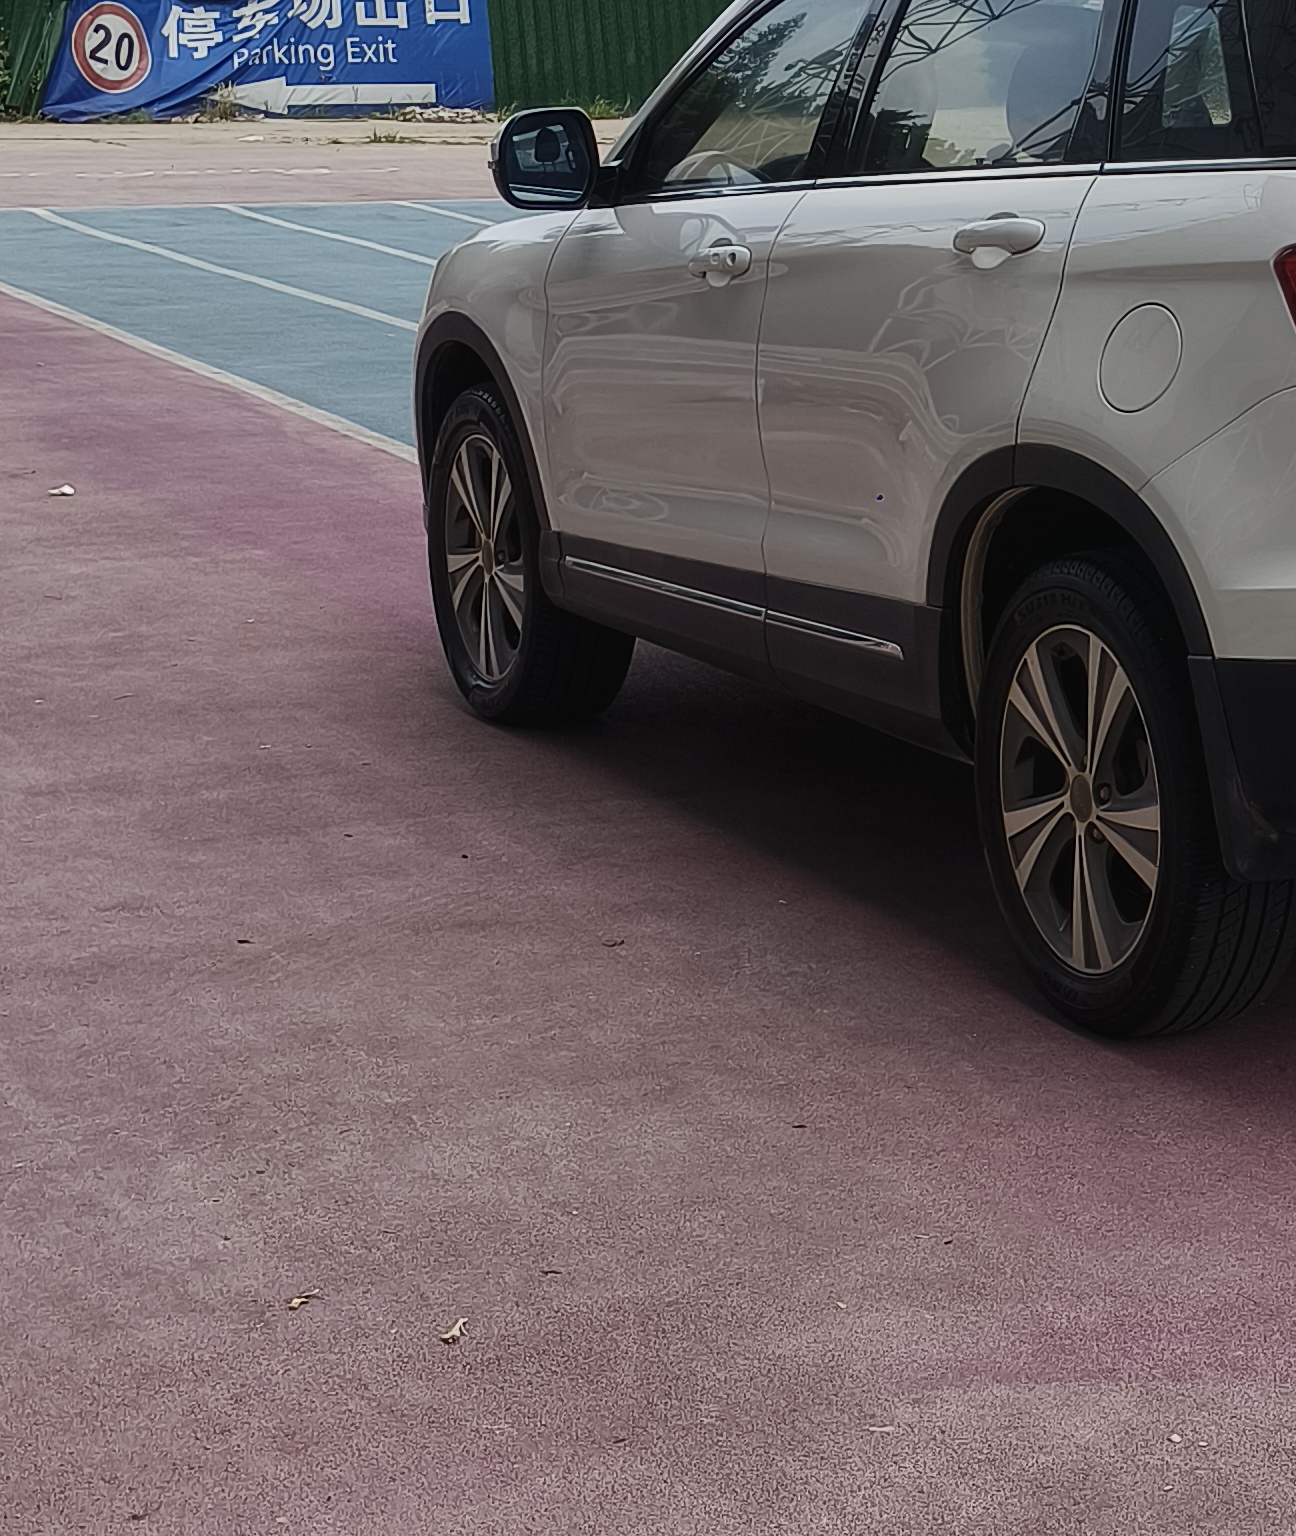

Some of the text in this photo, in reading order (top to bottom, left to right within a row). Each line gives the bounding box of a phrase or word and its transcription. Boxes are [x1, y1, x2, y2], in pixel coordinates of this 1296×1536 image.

[87, 23, 135, 72] 20
[232, 35, 398, 71] Parking Exit
